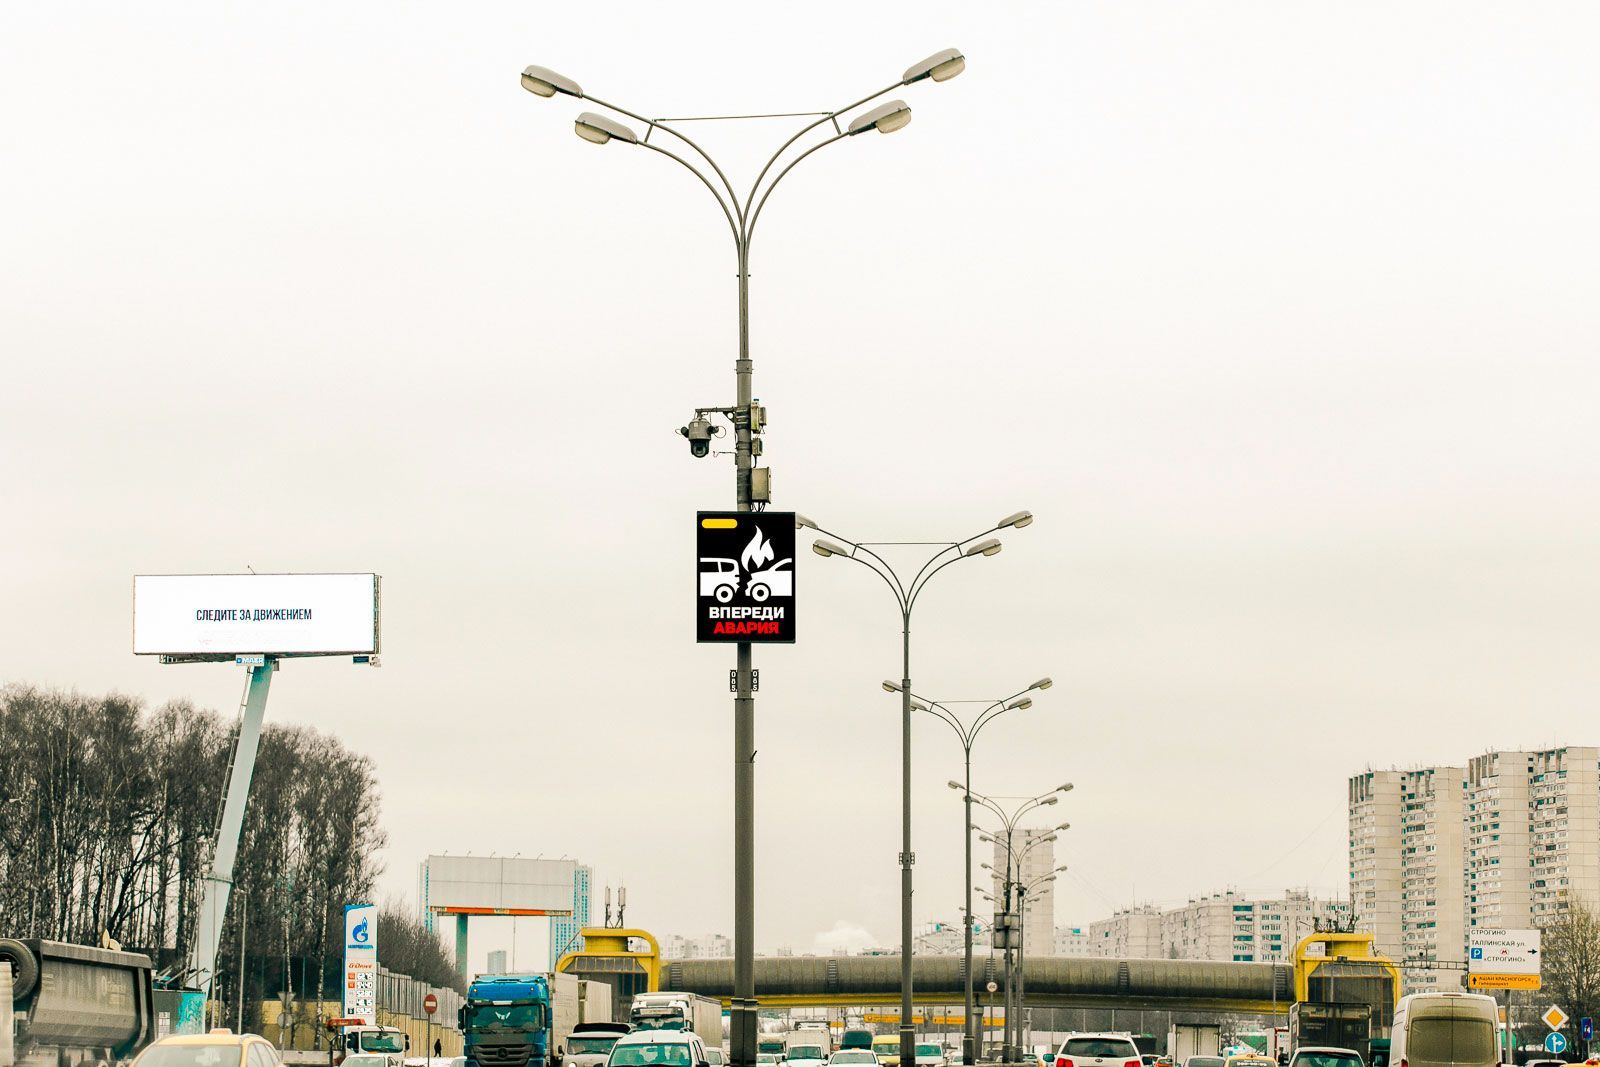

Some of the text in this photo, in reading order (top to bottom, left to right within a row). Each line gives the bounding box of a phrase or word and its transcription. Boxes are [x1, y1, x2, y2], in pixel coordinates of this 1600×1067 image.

[196, 608, 312, 622] СЛЕДИТЕ ЗА ДВИЖЕНИЕМ
[708, 606, 785, 621] ВПЕРЕДИ
[713, 621, 780, 634] АВАРИЯ
